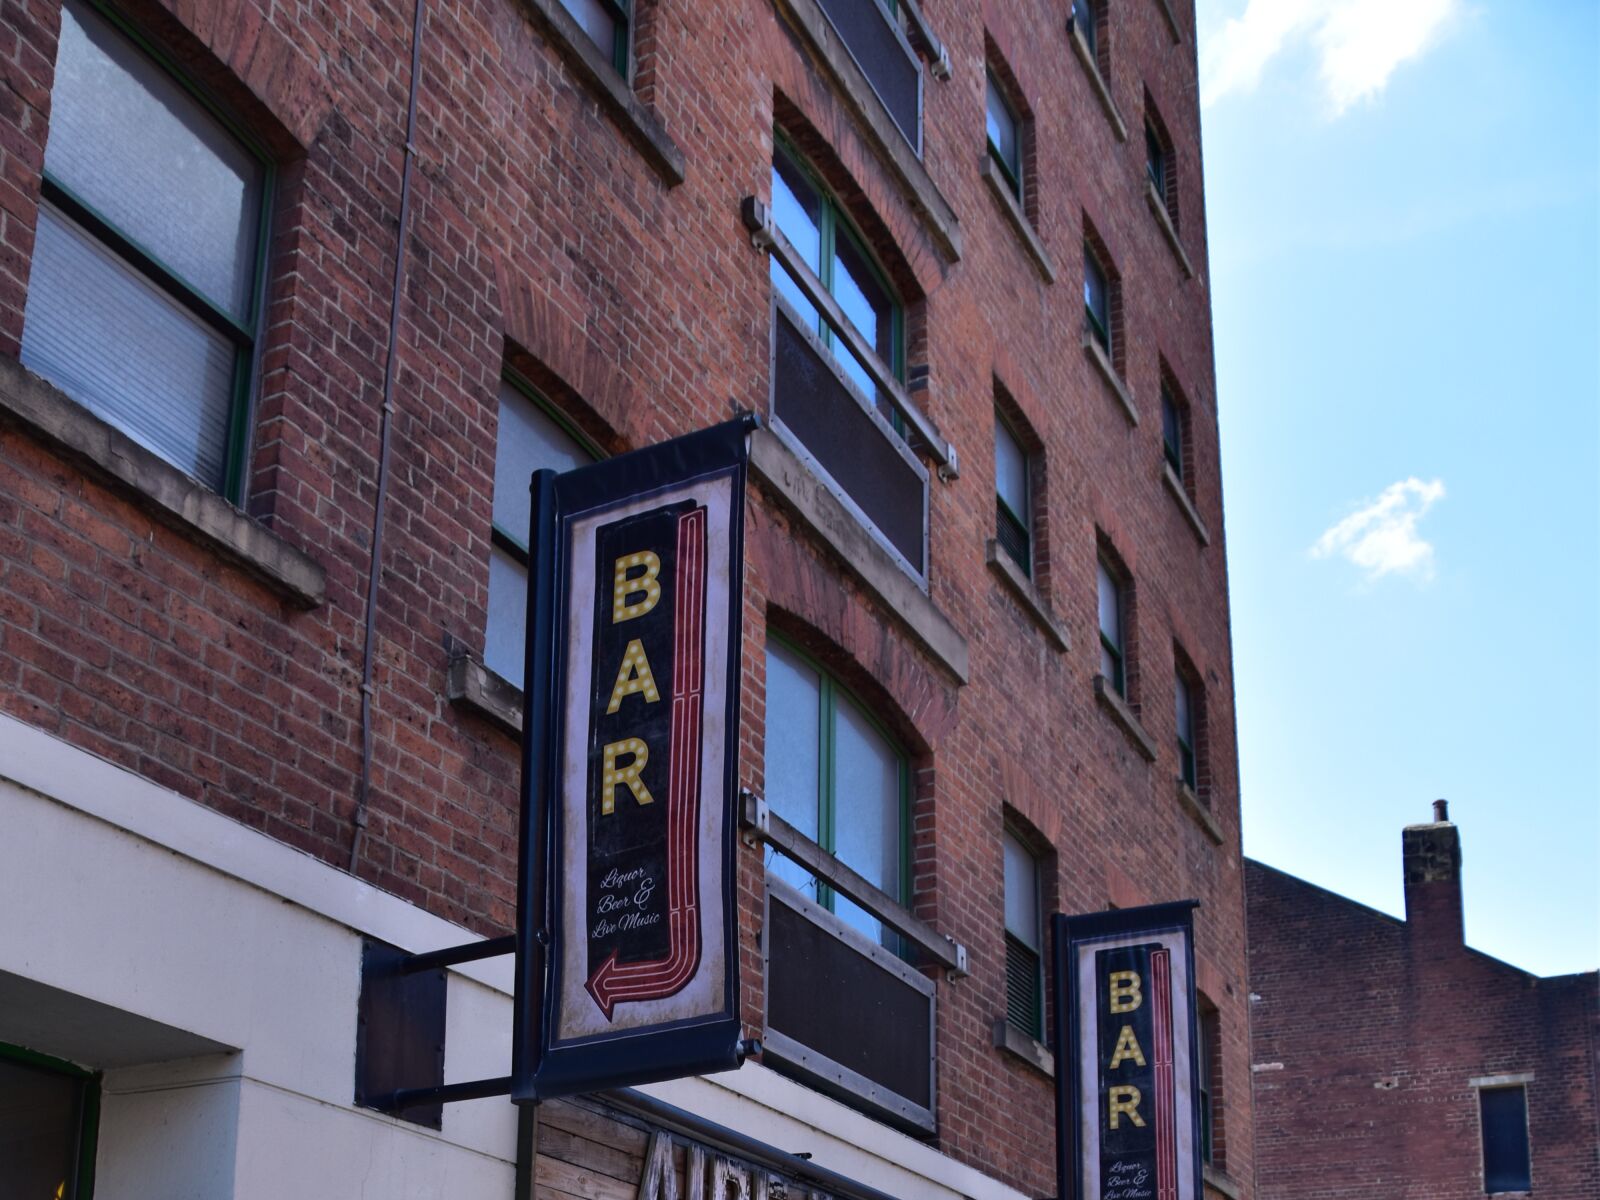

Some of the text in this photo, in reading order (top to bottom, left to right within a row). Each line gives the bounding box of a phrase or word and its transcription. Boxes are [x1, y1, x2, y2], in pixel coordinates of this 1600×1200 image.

[601, 550, 661, 816] BAR
[600, 867, 646, 889] Liquor
[597, 894, 630, 914] Beer
[591, 912, 660, 938] Live Music
[1109, 970, 1146, 1130] BAR
